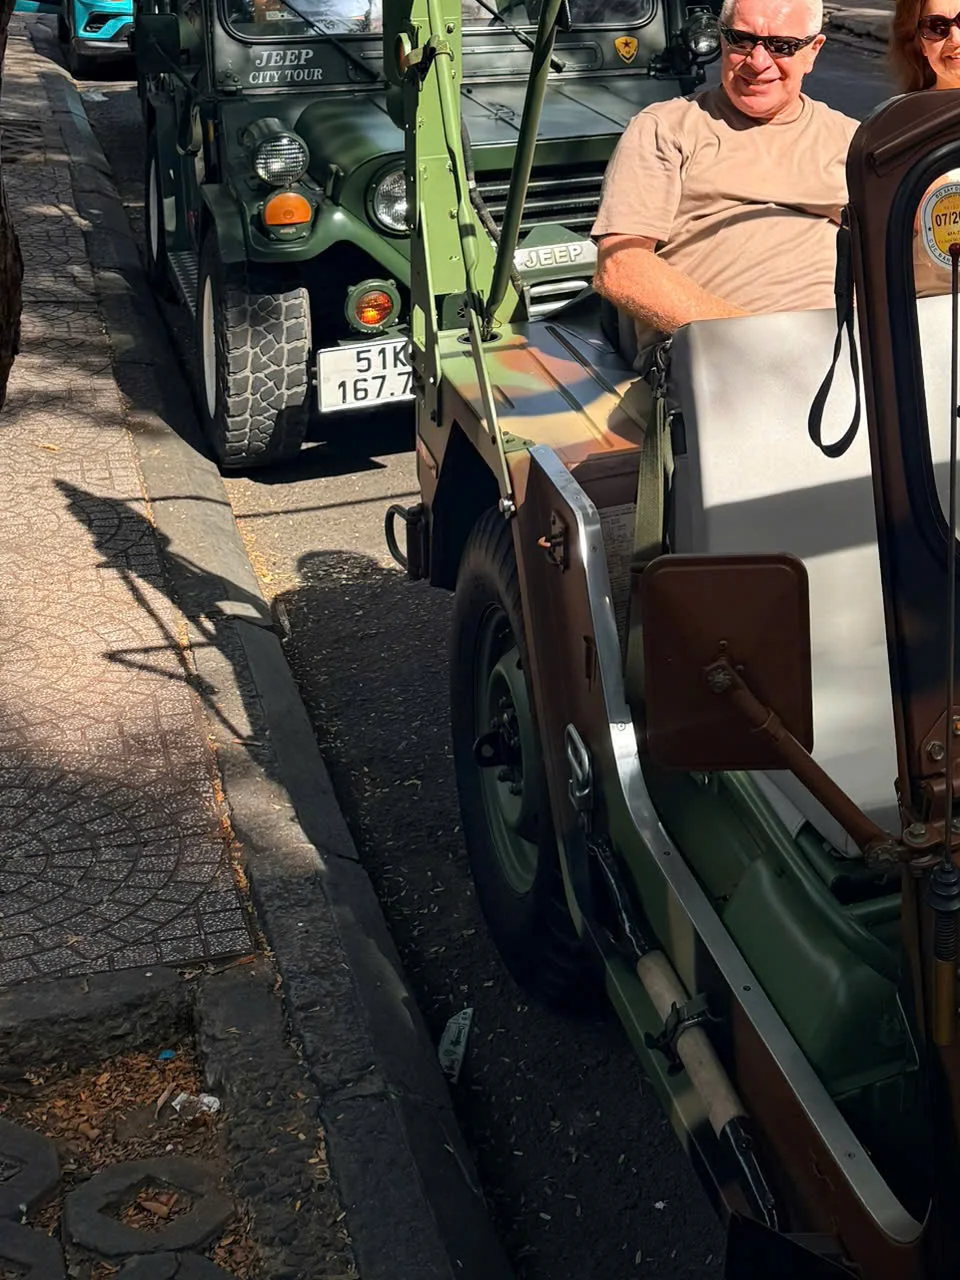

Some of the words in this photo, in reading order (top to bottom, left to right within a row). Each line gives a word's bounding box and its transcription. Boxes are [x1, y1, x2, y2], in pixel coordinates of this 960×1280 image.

[255, 49, 314, 67] JEEP
[249, 70, 282, 84] CITY
[285, 68, 323, 82] TOUR
[525, 245, 582, 268] JEEP
[356, 345, 408, 373] 51K
[338, 371, 413, 404] 167.7
